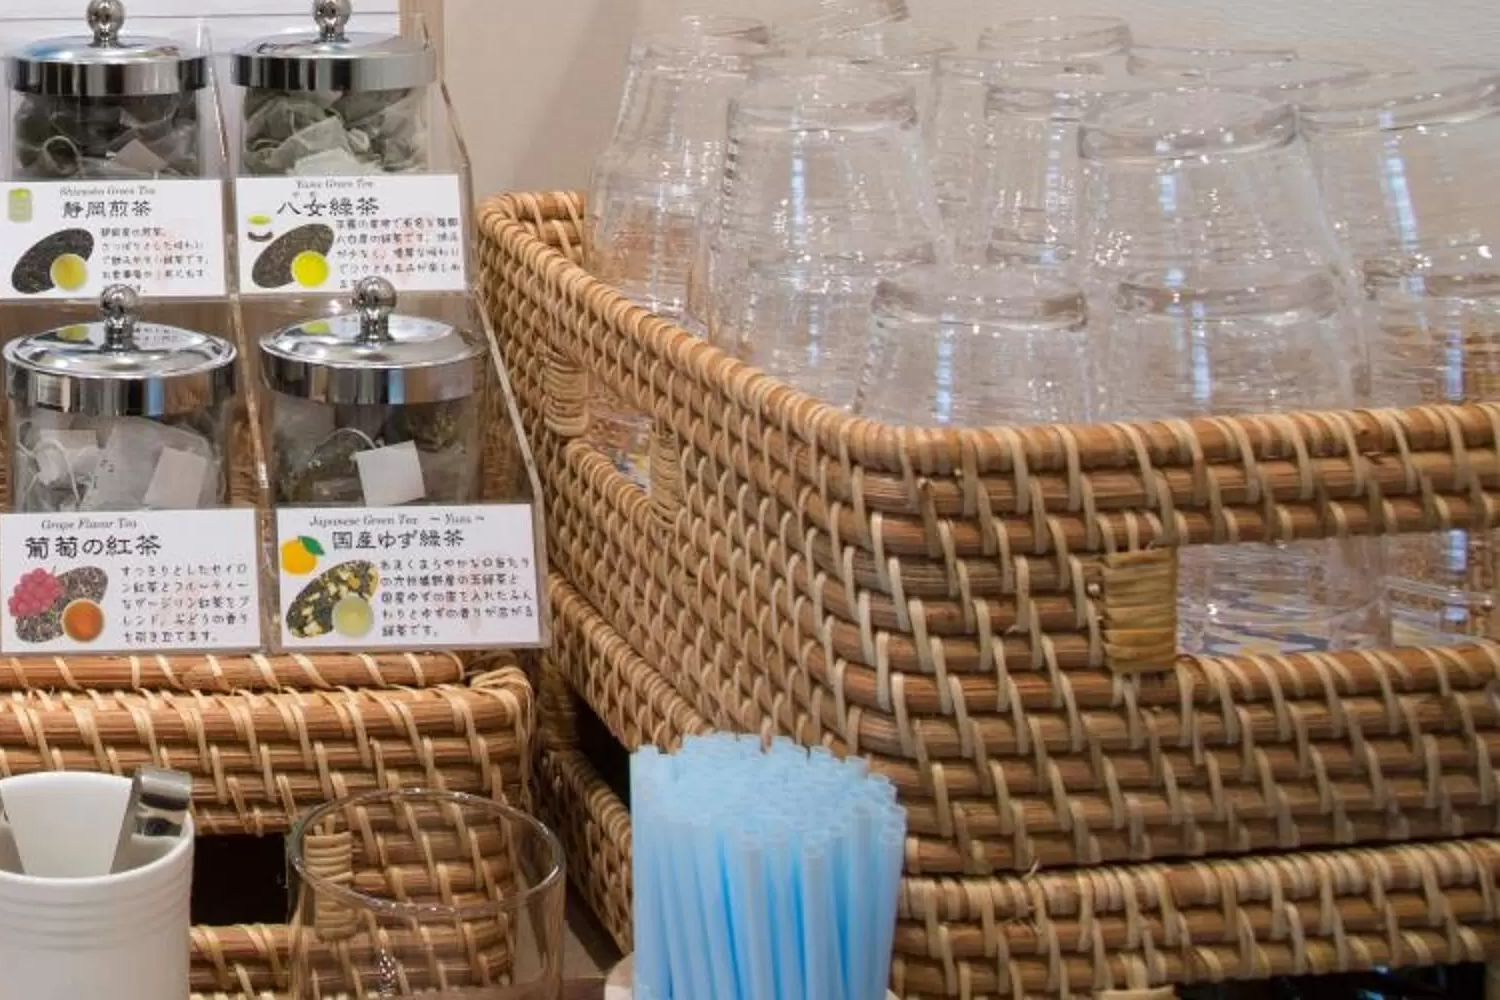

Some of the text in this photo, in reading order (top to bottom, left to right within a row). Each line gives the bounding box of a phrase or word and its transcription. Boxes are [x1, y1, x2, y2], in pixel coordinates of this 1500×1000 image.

[25, 535, 162, 559] 葡萄の紅茶
[332, 530, 465, 550] 国産ゆず緑茶
